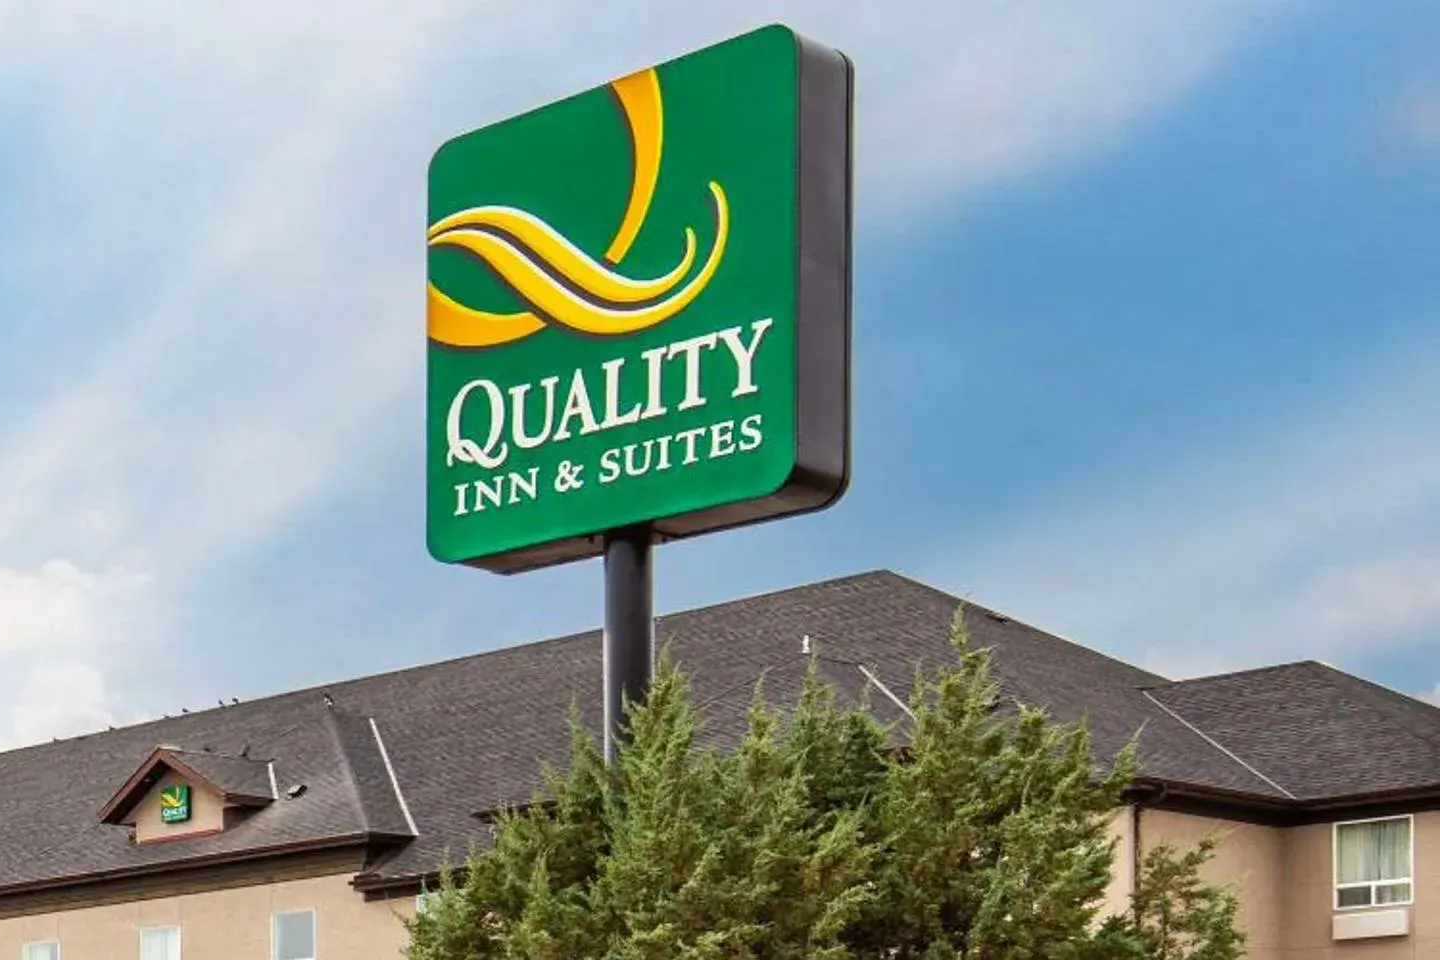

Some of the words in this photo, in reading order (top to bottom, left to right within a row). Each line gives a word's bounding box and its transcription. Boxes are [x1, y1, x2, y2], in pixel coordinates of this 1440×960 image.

[446, 318, 773, 468] QUALITY
[453, 467, 540, 516] INN
[554, 459, 584, 493] &
[598, 414, 763, 483] SUITES
